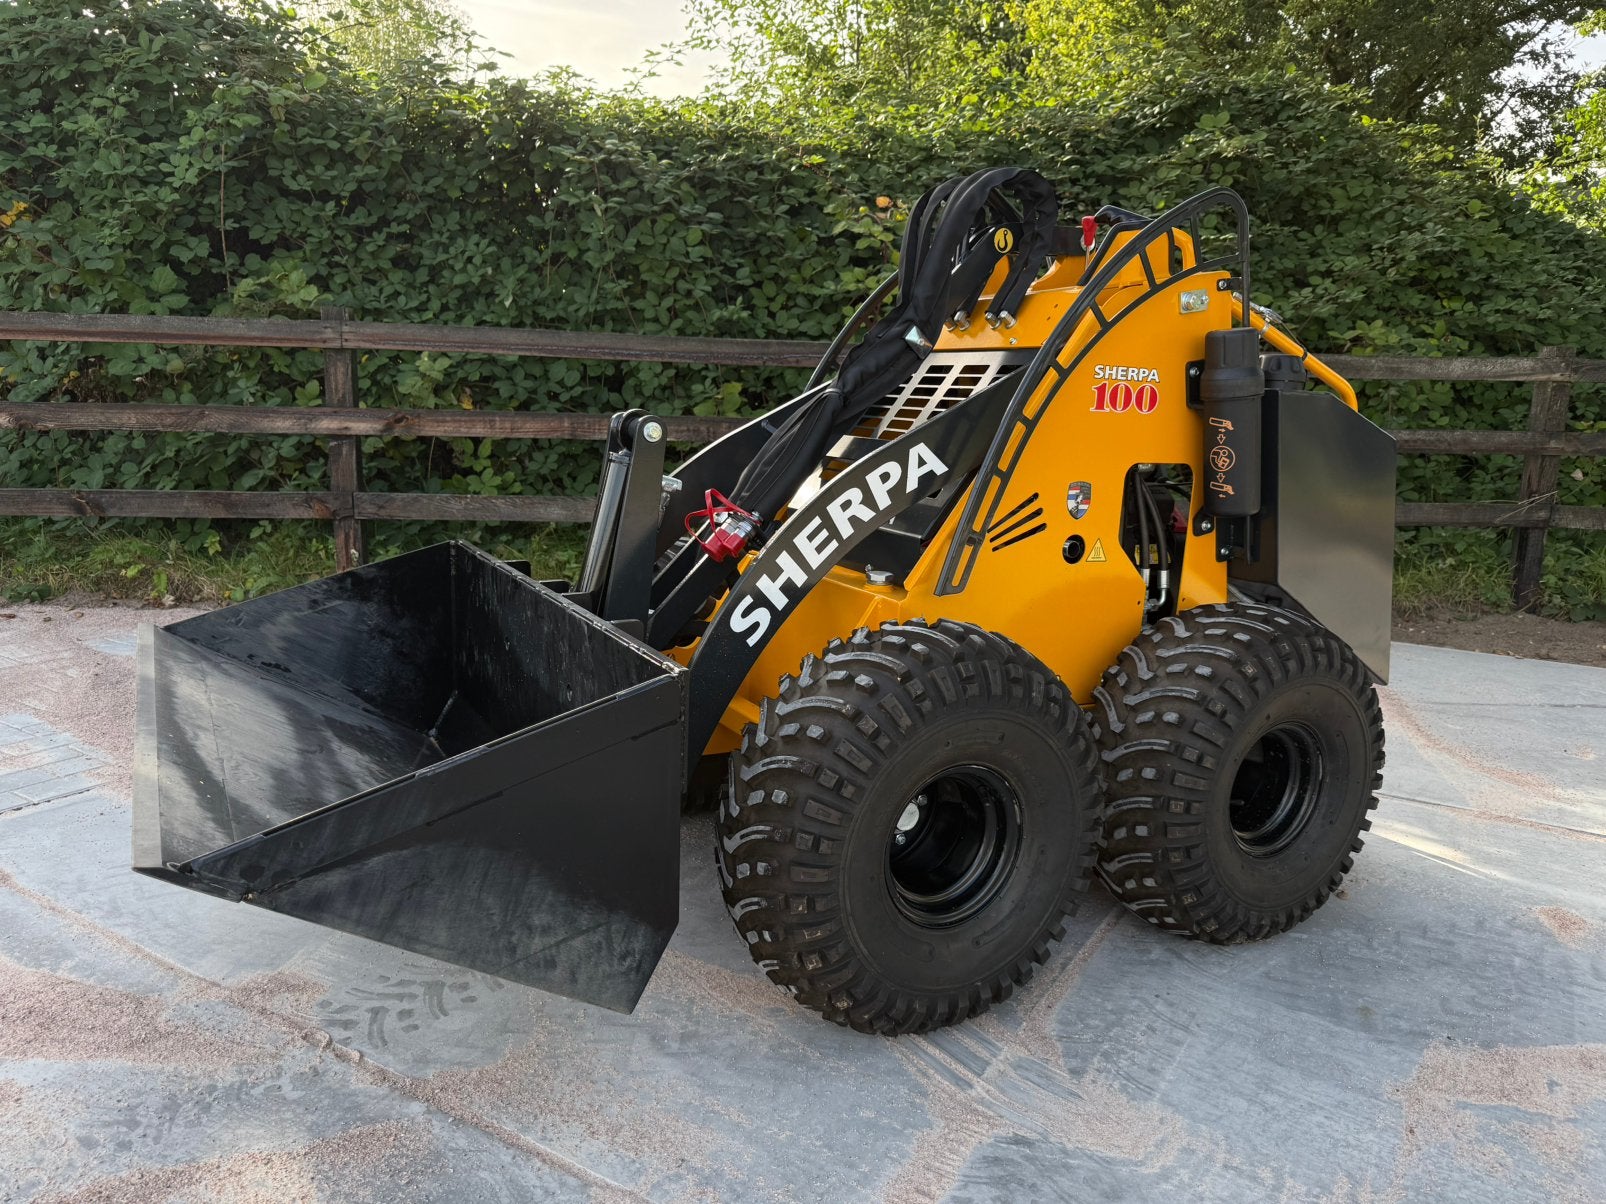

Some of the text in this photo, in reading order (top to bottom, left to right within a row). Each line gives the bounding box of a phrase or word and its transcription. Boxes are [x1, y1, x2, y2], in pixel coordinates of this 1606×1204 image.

[1094, 364, 1160, 382] SHERPA
[1090, 381, 1159, 414] 100
[730, 442, 949, 648] SHERPA
